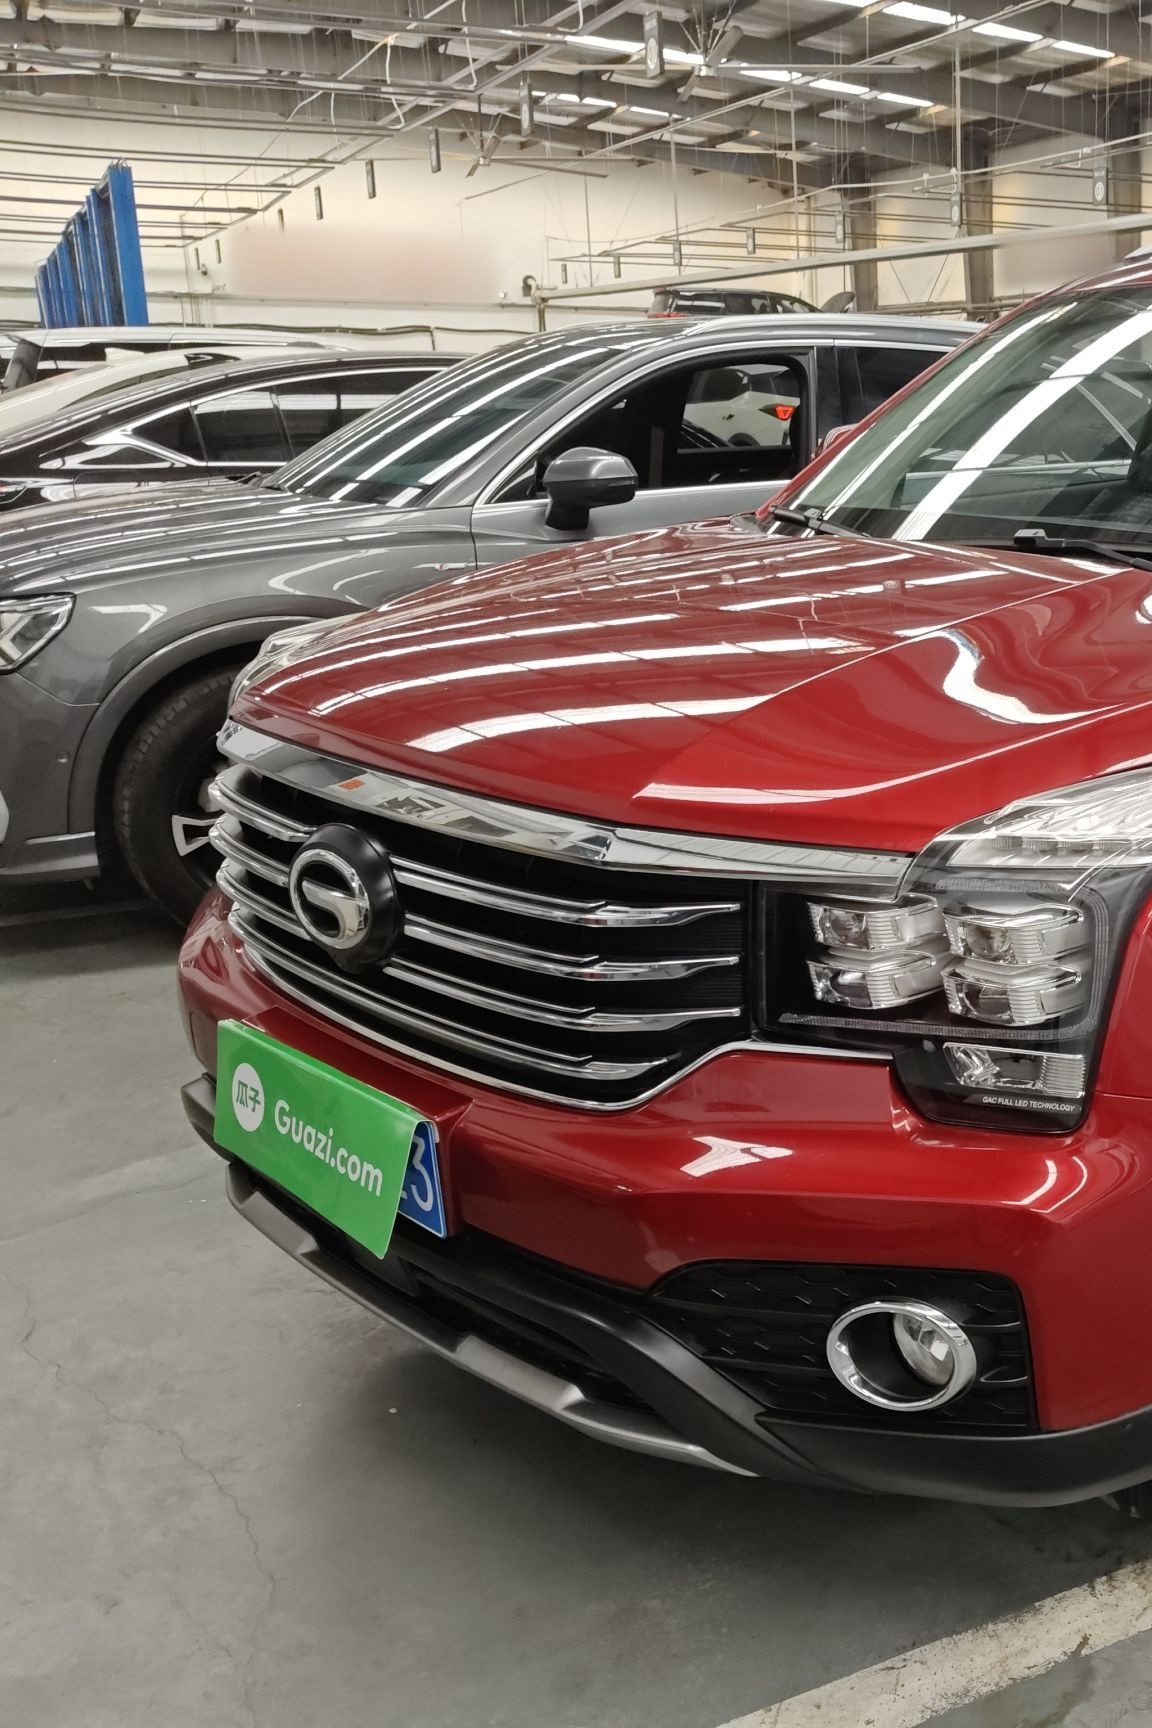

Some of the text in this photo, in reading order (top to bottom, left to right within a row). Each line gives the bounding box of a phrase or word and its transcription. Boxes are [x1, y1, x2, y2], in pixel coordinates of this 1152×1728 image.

[236, 1080, 261, 1112] 瓜子
[982, 1096, 1076, 1112] GAC FULL LED TECHNOLOGY
[274, 1099, 383, 1197] Guazi.com
